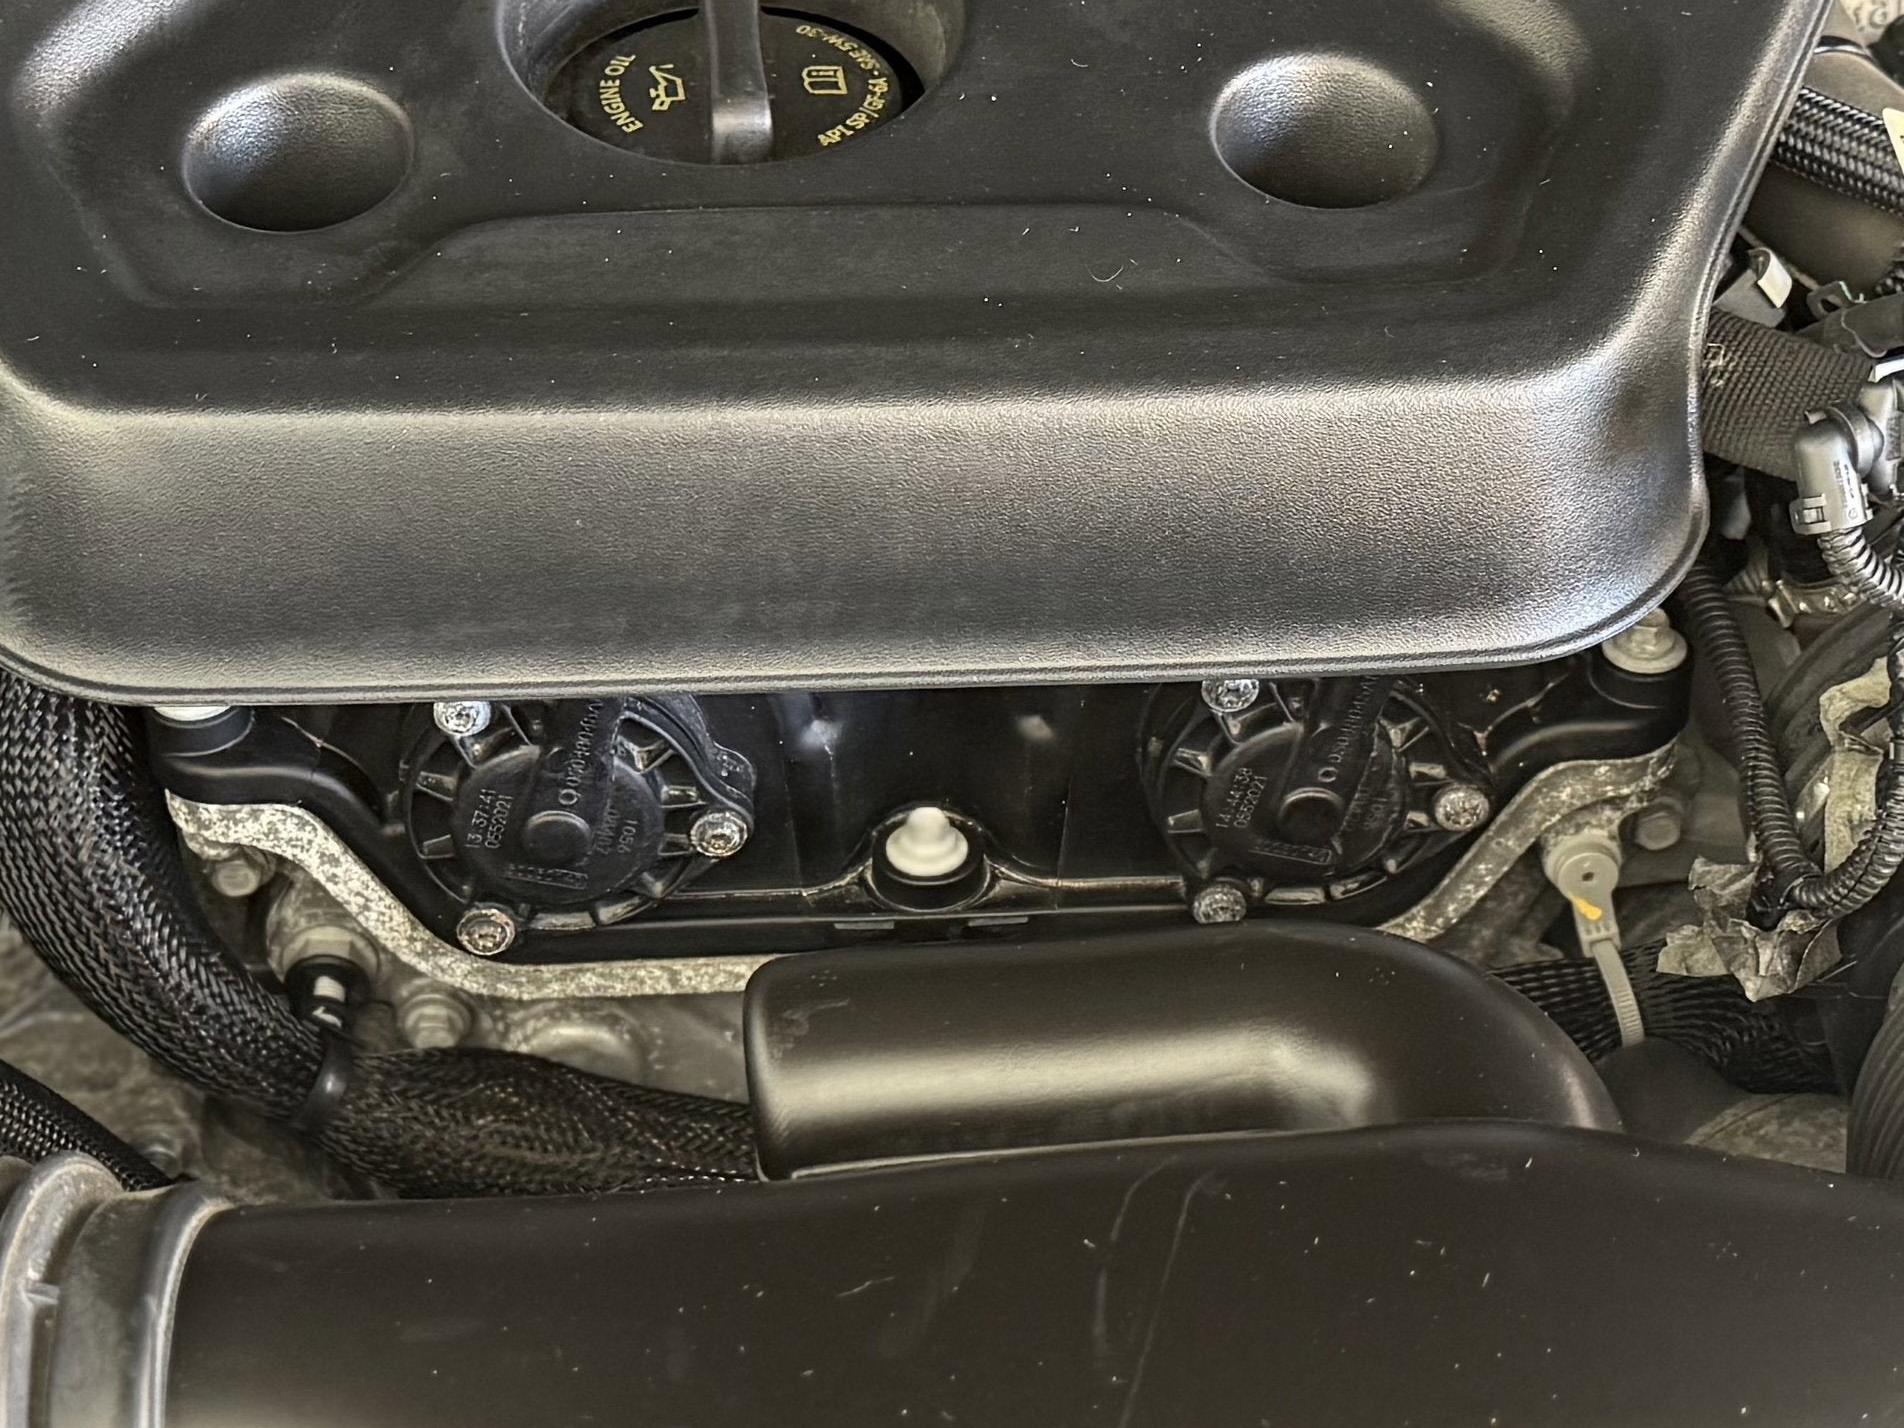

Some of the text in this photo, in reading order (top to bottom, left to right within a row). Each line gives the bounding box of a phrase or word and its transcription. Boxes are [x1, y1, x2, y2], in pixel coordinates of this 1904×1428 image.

[598, 52, 645, 135] ENGINE OIL
[796, 24, 891, 147] API SP/GF-6A SAE 5W-30
[485, 794, 514, 849] 0552021
